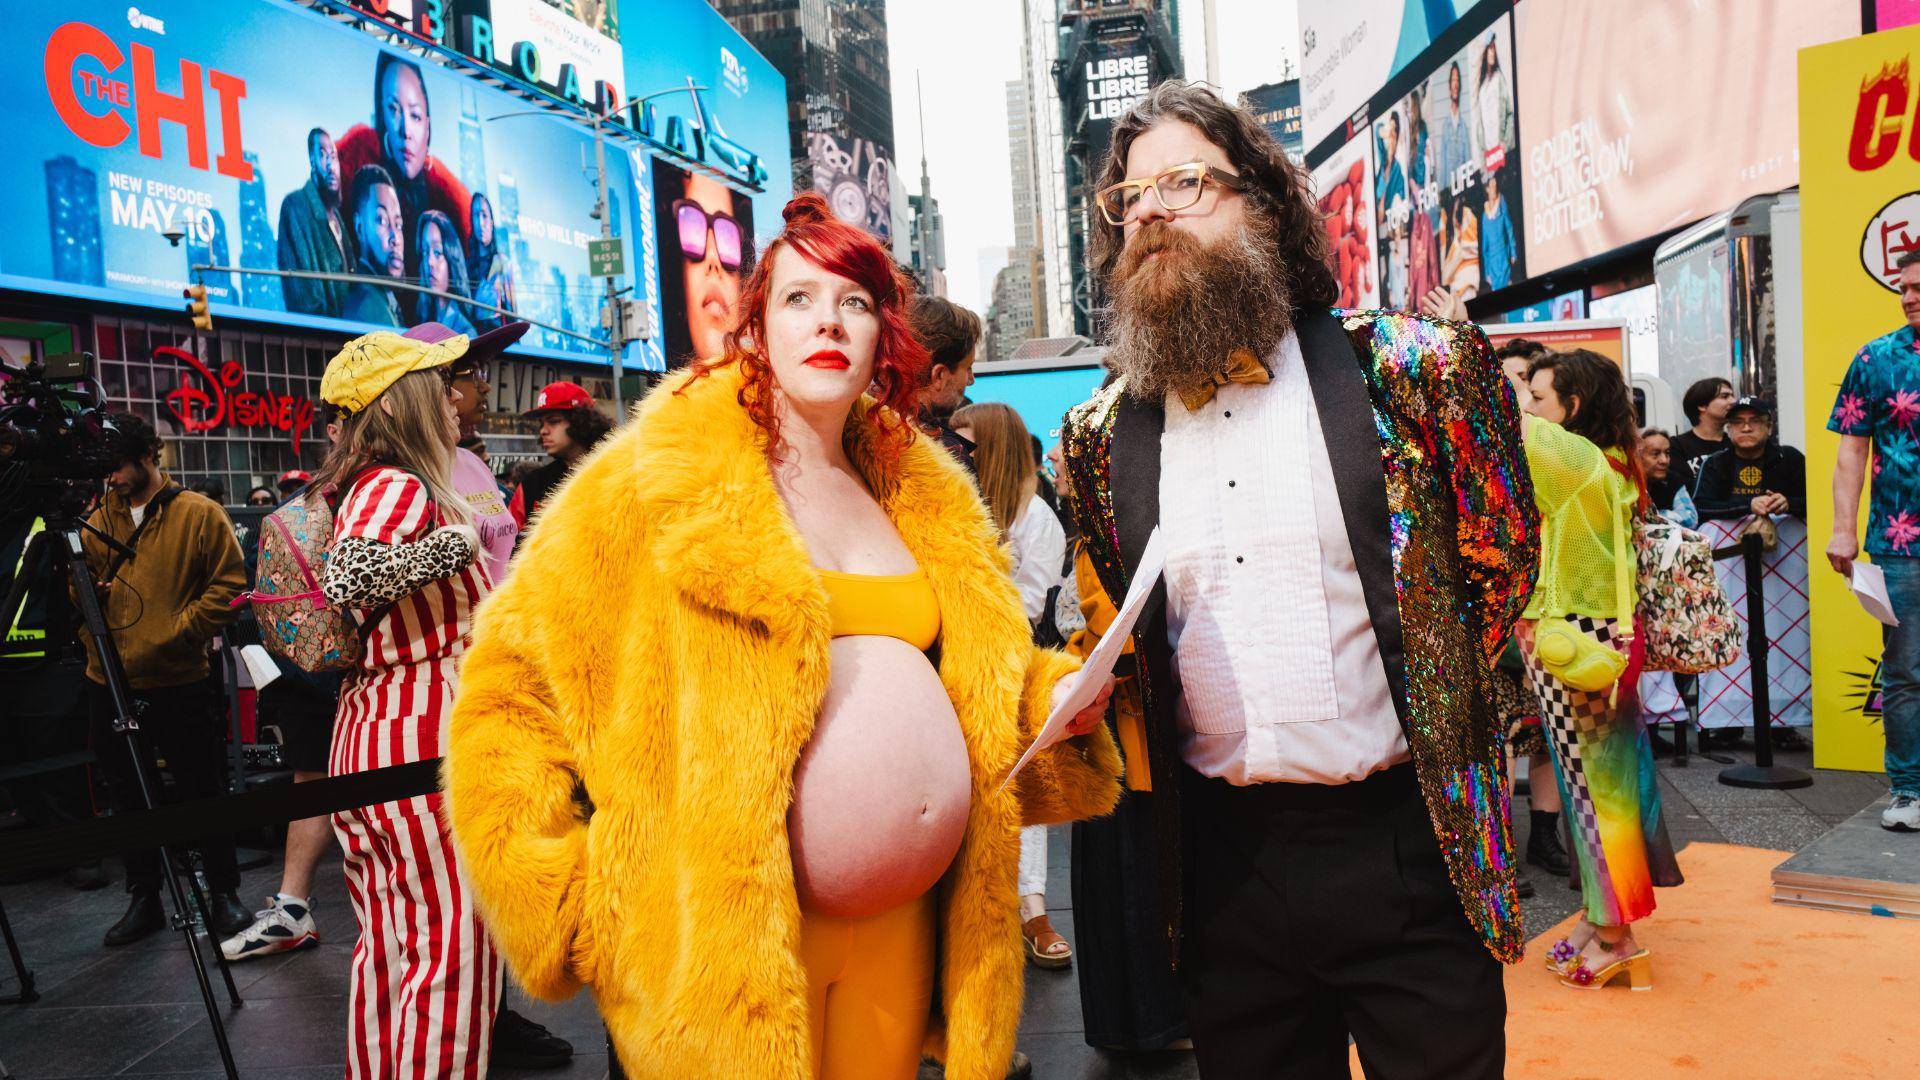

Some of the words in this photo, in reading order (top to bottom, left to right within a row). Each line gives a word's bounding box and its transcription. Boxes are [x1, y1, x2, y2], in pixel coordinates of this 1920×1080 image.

[78, 70, 131, 108] THE
[1086, 55, 1148, 81] LIBRE
[1087, 75, 1150, 101] LIBRE
[44, 21, 254, 182] CHI
[1088, 96, 1150, 120] LIBR
[1530, 116, 1601, 178] GOLDEN
[1532, 161, 1579, 206] HOUR
[1580, 132, 1634, 189] GLOW,
[109, 171, 142, 194] NEW
[146, 180, 213, 209] EPISODES
[1420, 181, 1439, 214] FOR
[1450, 160, 1475, 197] LIFE
[110, 189, 177, 233] MAY
[183, 206, 215, 247] 10
[517, 214, 546, 238] WHO
[546, 222, 573, 245] WILL
[1534, 188, 1604, 245] BOTTLED.
